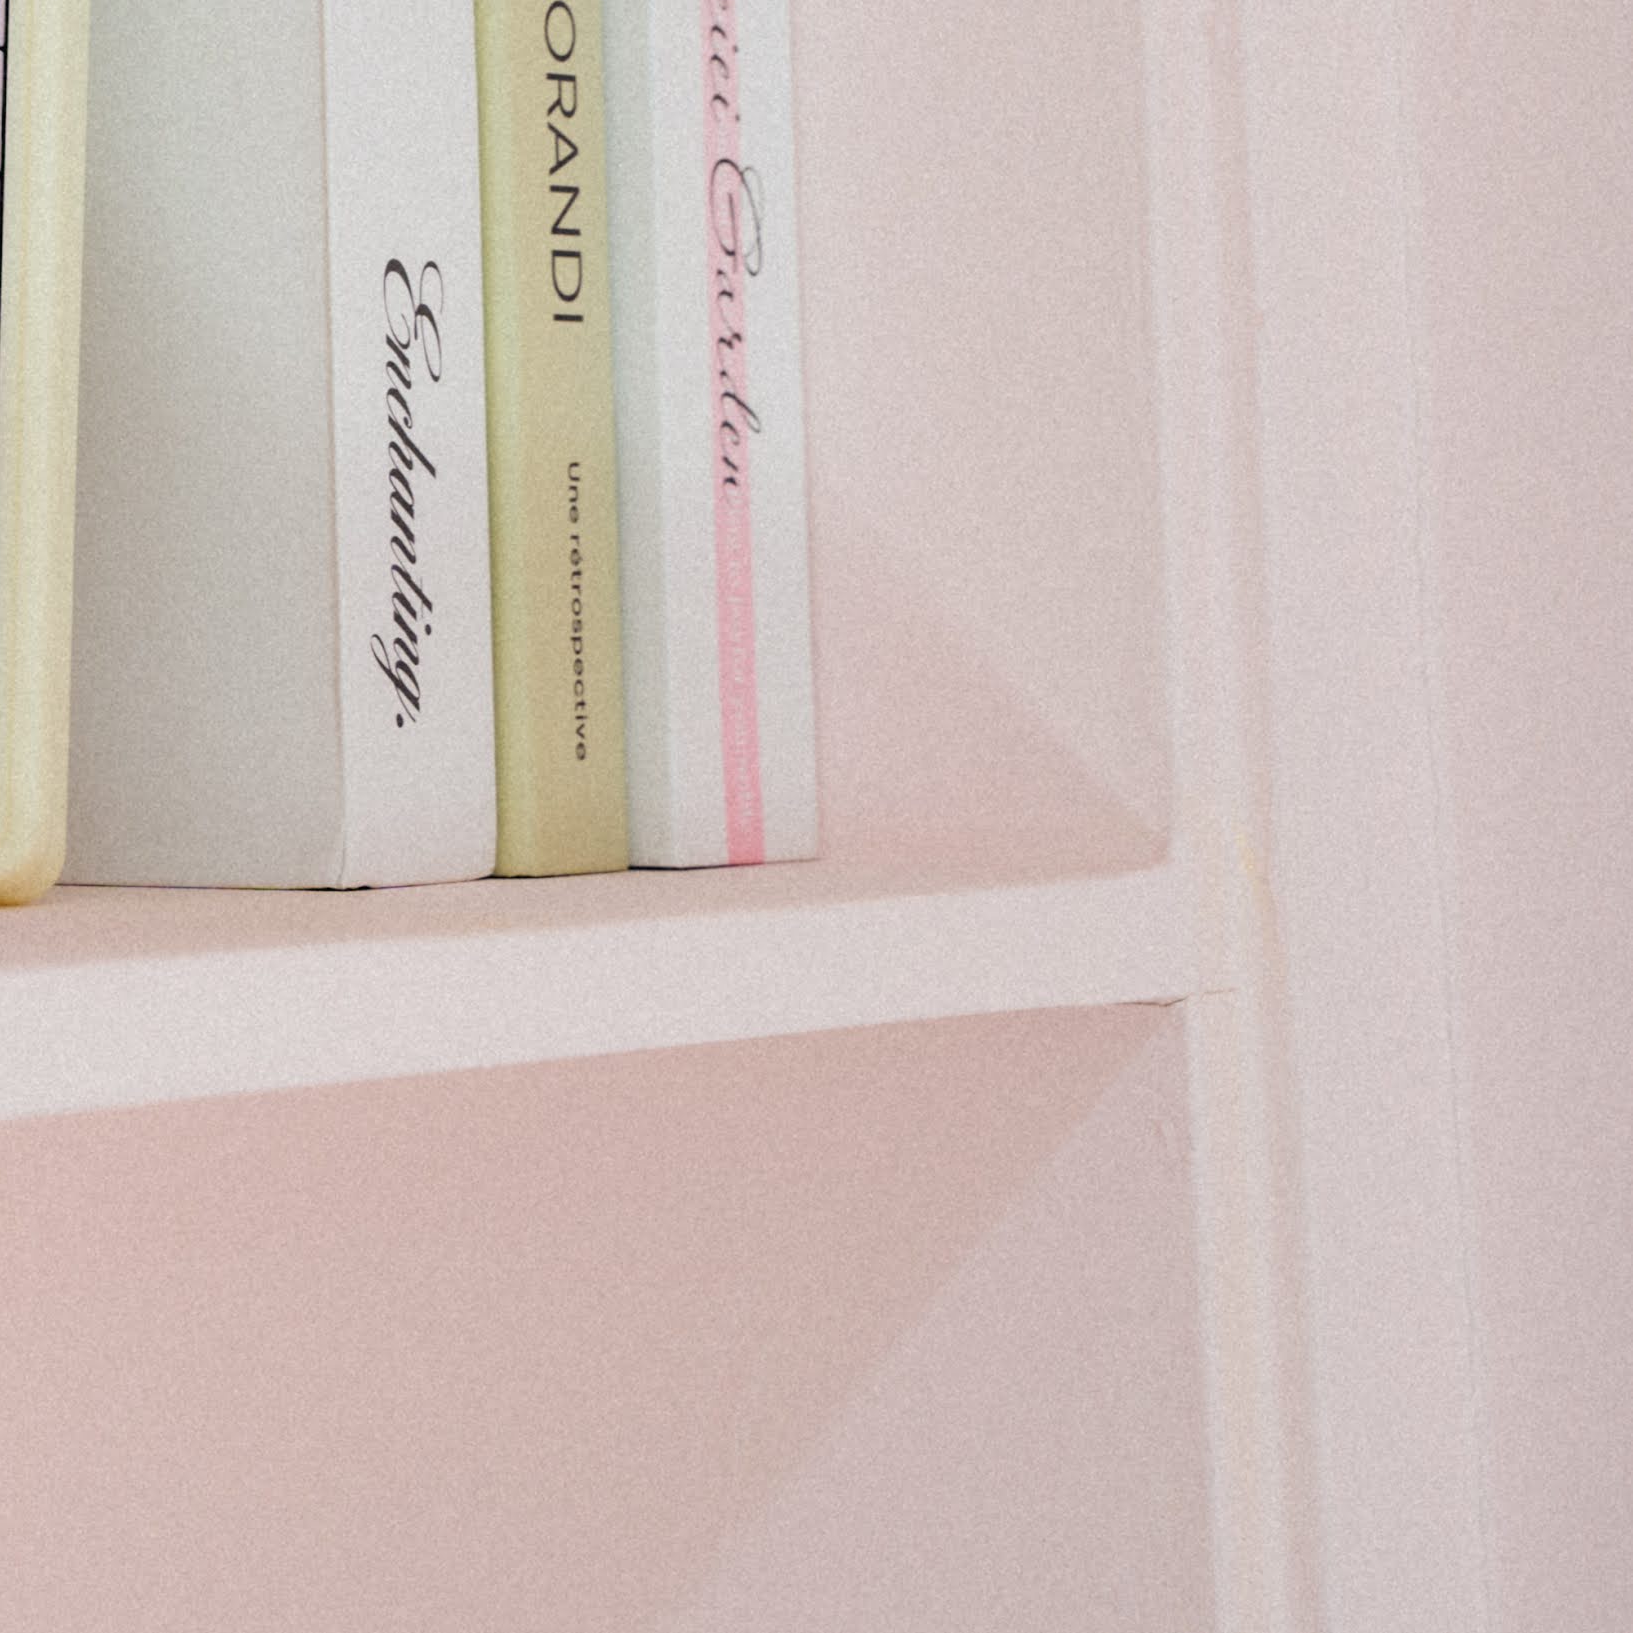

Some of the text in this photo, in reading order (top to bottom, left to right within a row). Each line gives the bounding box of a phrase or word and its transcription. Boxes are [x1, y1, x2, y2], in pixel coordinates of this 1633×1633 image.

[371, 257, 446, 730] Enchanting.
[565, 459, 589, 763] Une rétrospective
